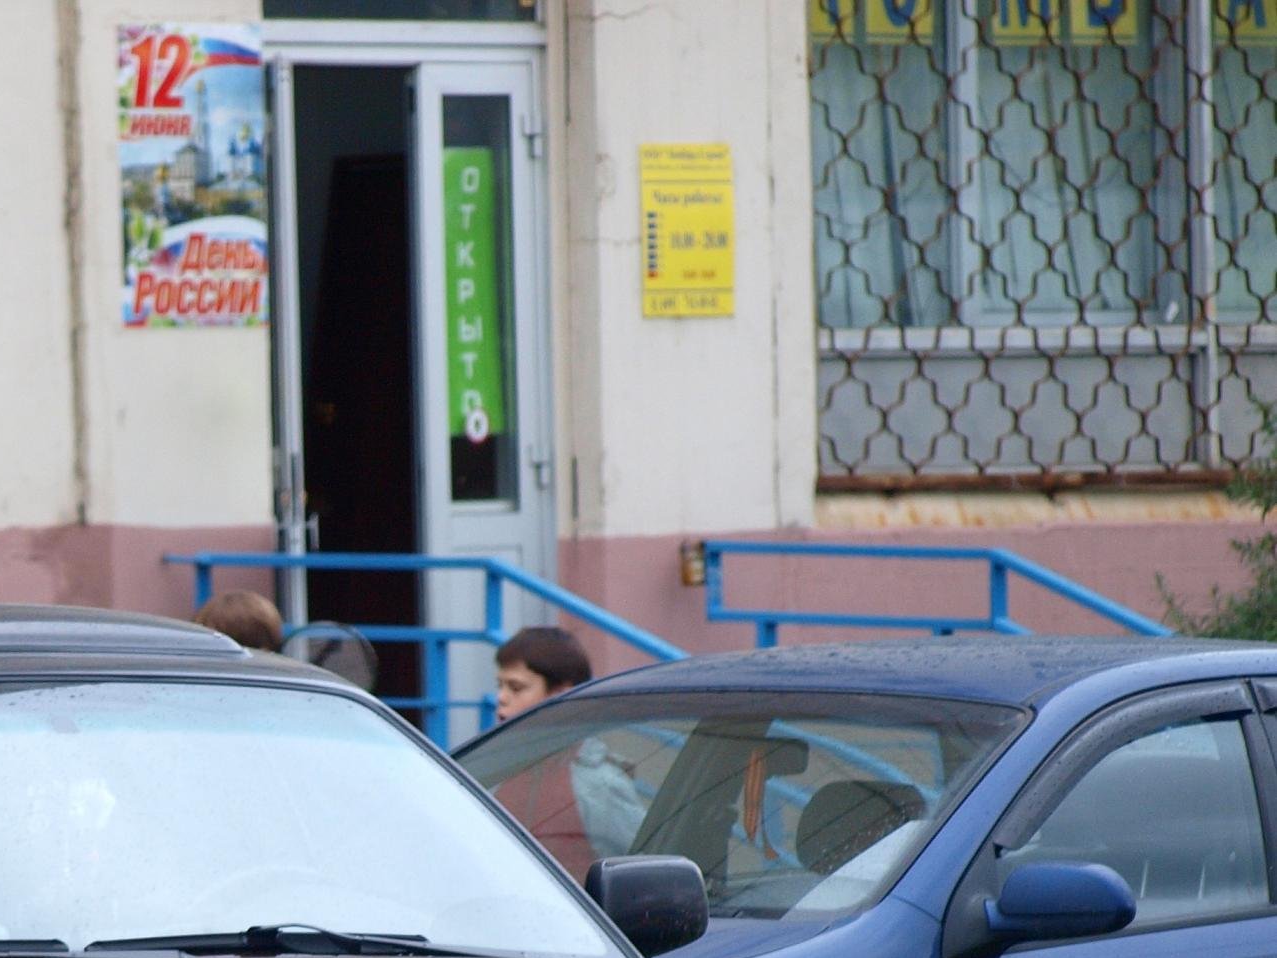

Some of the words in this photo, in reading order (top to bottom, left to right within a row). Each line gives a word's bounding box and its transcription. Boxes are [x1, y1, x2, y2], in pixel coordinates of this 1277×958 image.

[131, 34, 192, 108] 12
[182, 233, 256, 272] День
[456, 166, 483, 417] ОТКРЫТО
